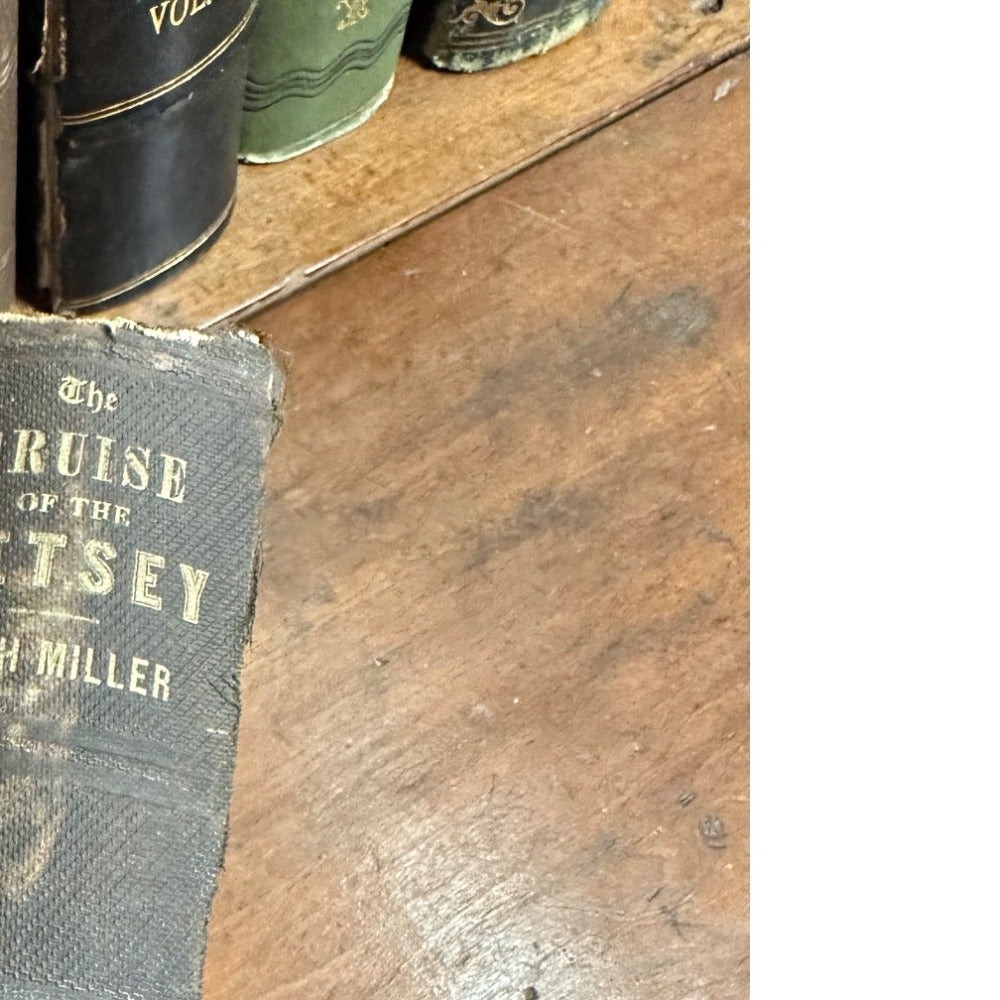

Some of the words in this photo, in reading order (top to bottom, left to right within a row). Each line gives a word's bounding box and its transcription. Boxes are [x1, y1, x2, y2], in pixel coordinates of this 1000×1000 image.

[58, 374, 119, 414] The
[18, 492, 59, 515] OF
[69, 496, 132, 527] THE
[35, 639, 172, 702] MILLER
